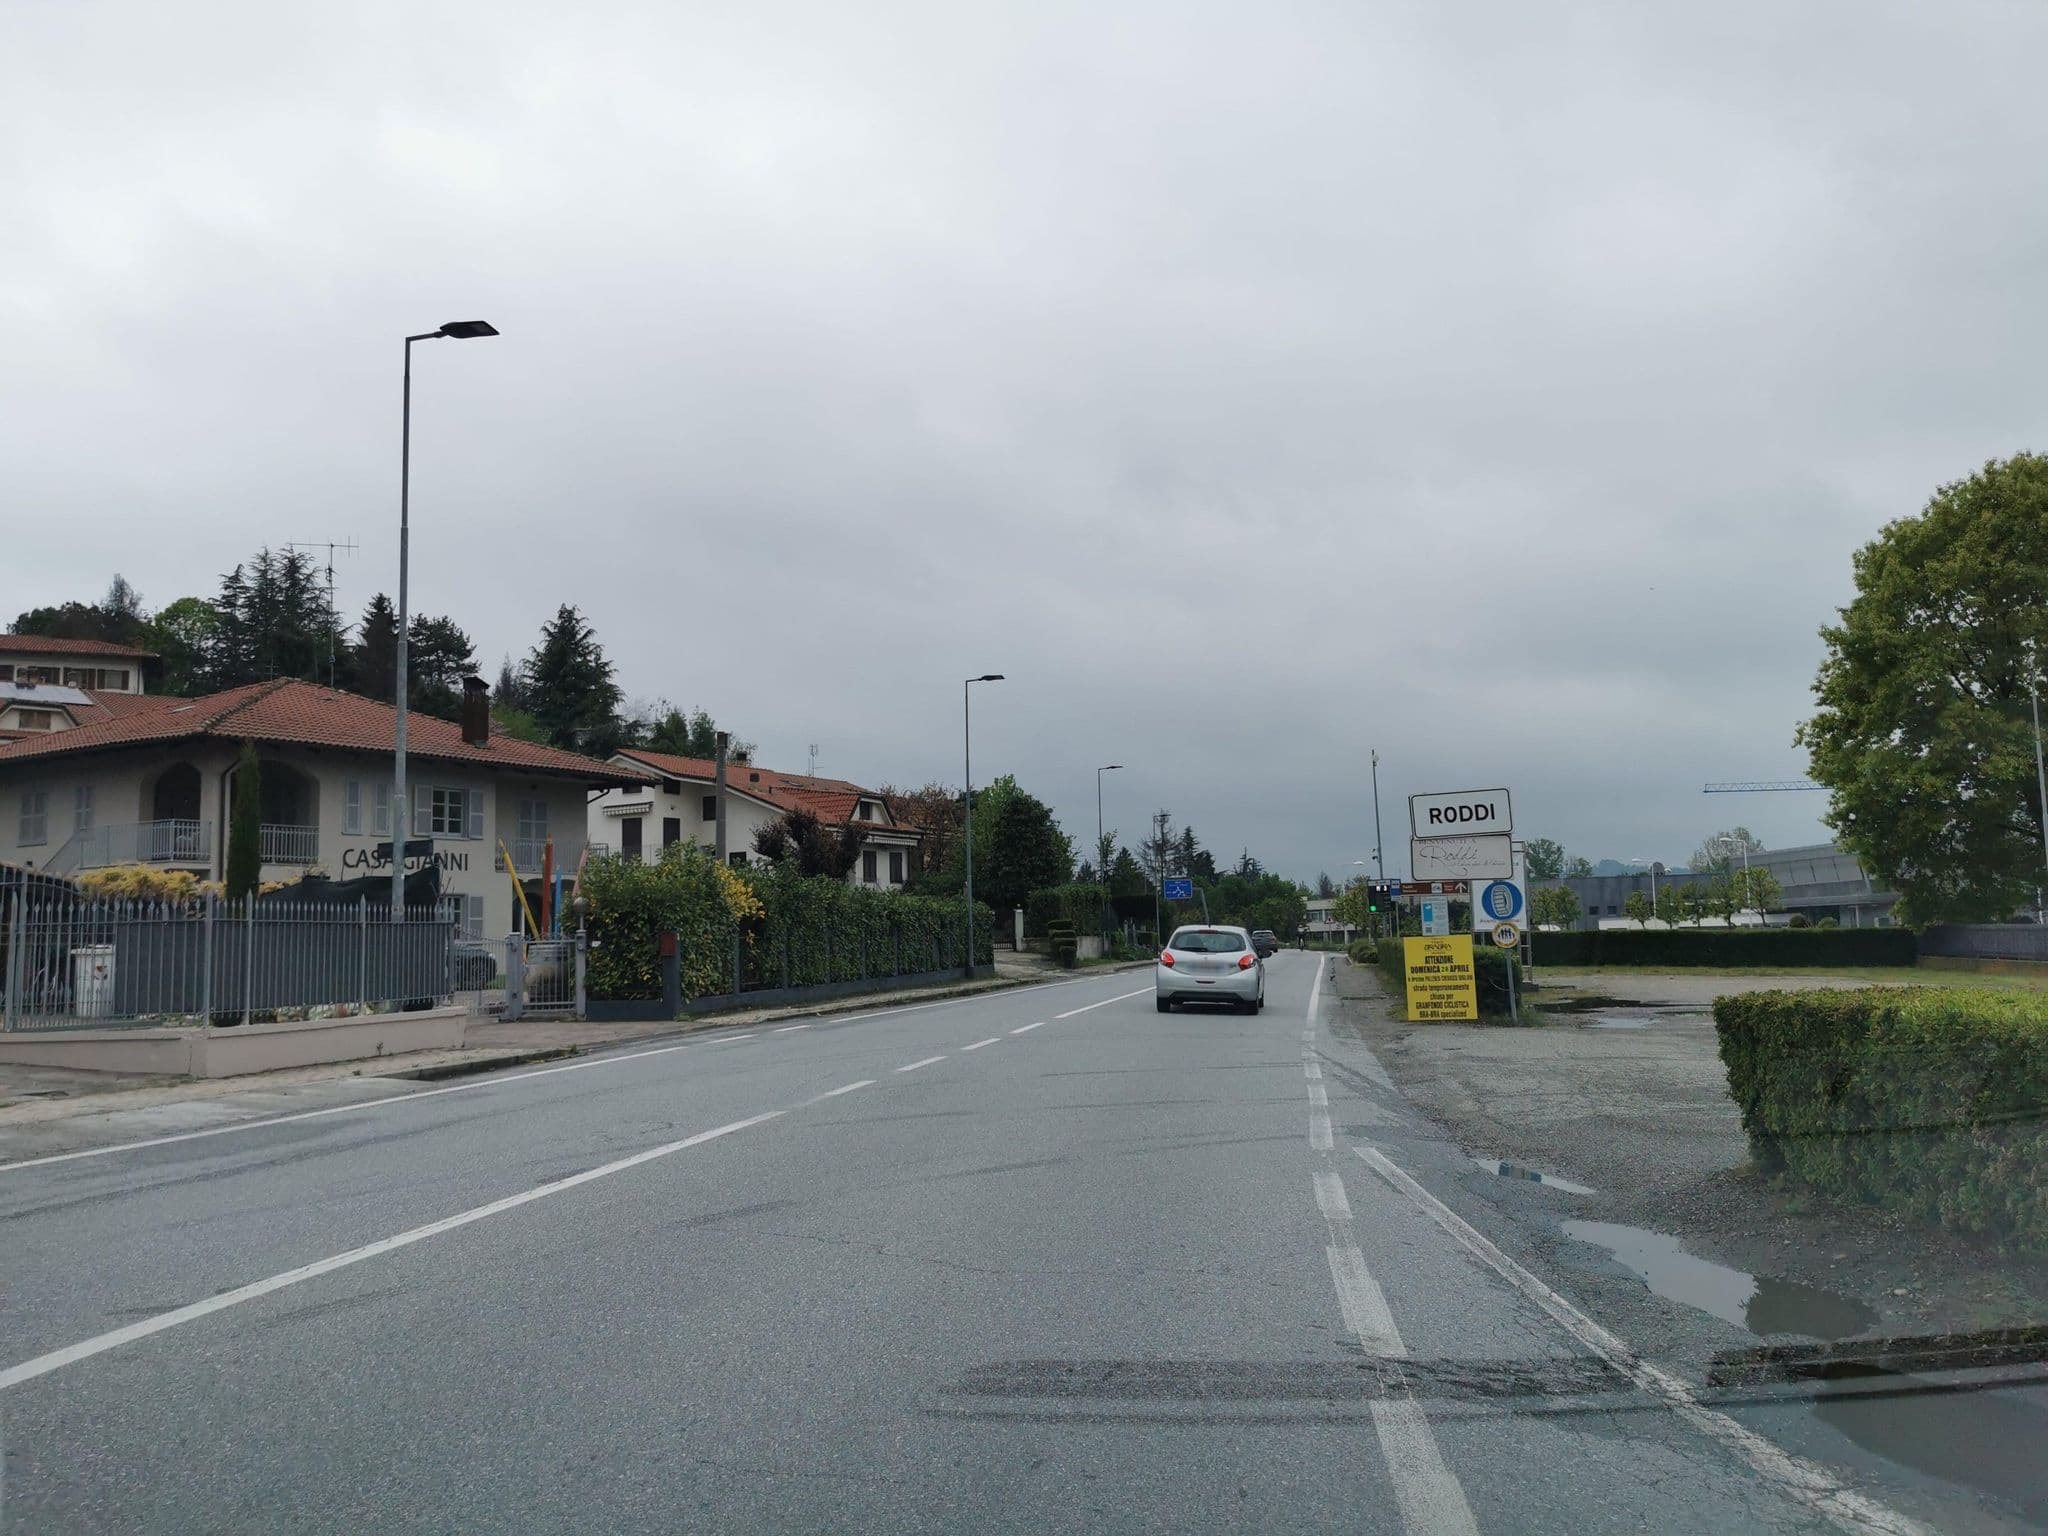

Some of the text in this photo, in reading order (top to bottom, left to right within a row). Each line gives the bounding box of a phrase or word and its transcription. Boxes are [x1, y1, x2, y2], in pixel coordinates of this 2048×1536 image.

[1429, 803, 1495, 824] RODDI
[1425, 955, 1454, 964] ATTENZIONE
[1410, 965, 1440, 974] DOMENICA
[1450, 964, 1469, 972] APRILE
[1416, 1000, 1469, 1009] GRANFONDO CICLISTICA
